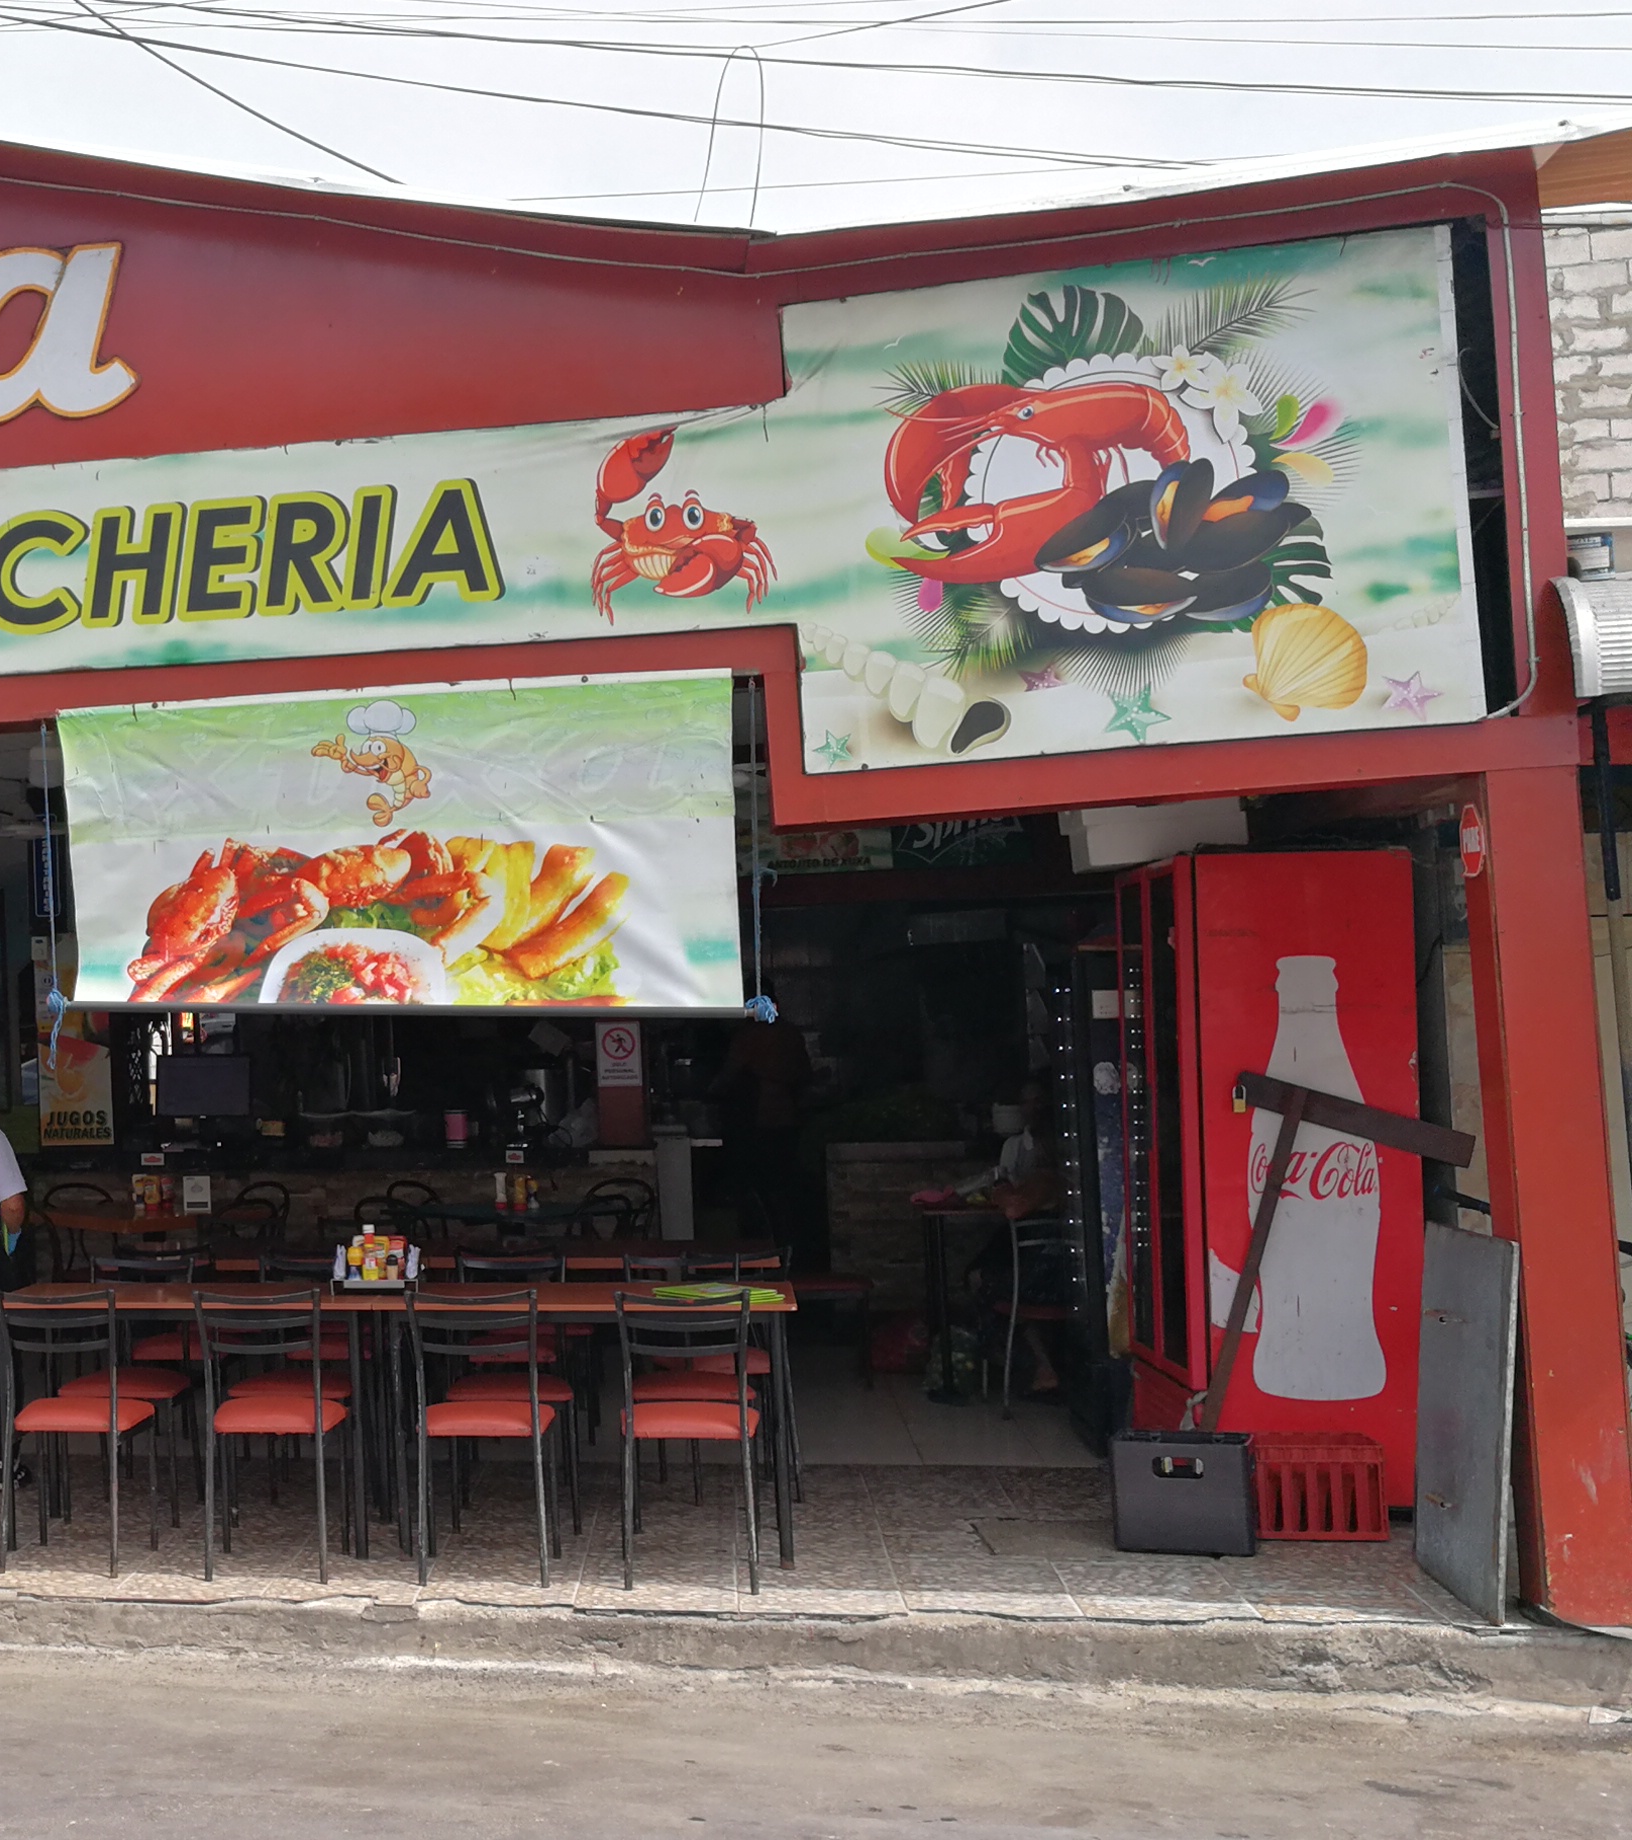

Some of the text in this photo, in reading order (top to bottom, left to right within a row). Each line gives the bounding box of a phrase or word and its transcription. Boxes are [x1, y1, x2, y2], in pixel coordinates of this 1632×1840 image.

[1462, 826, 1481, 854] PARE
[767, 858, 819, 869] ANTOJITO
[47, 1110, 107, 1127] JUGOS
[43, 1127, 112, 1139] NATURALES
[1251, 1141, 1376, 1201] Coa-Cola
